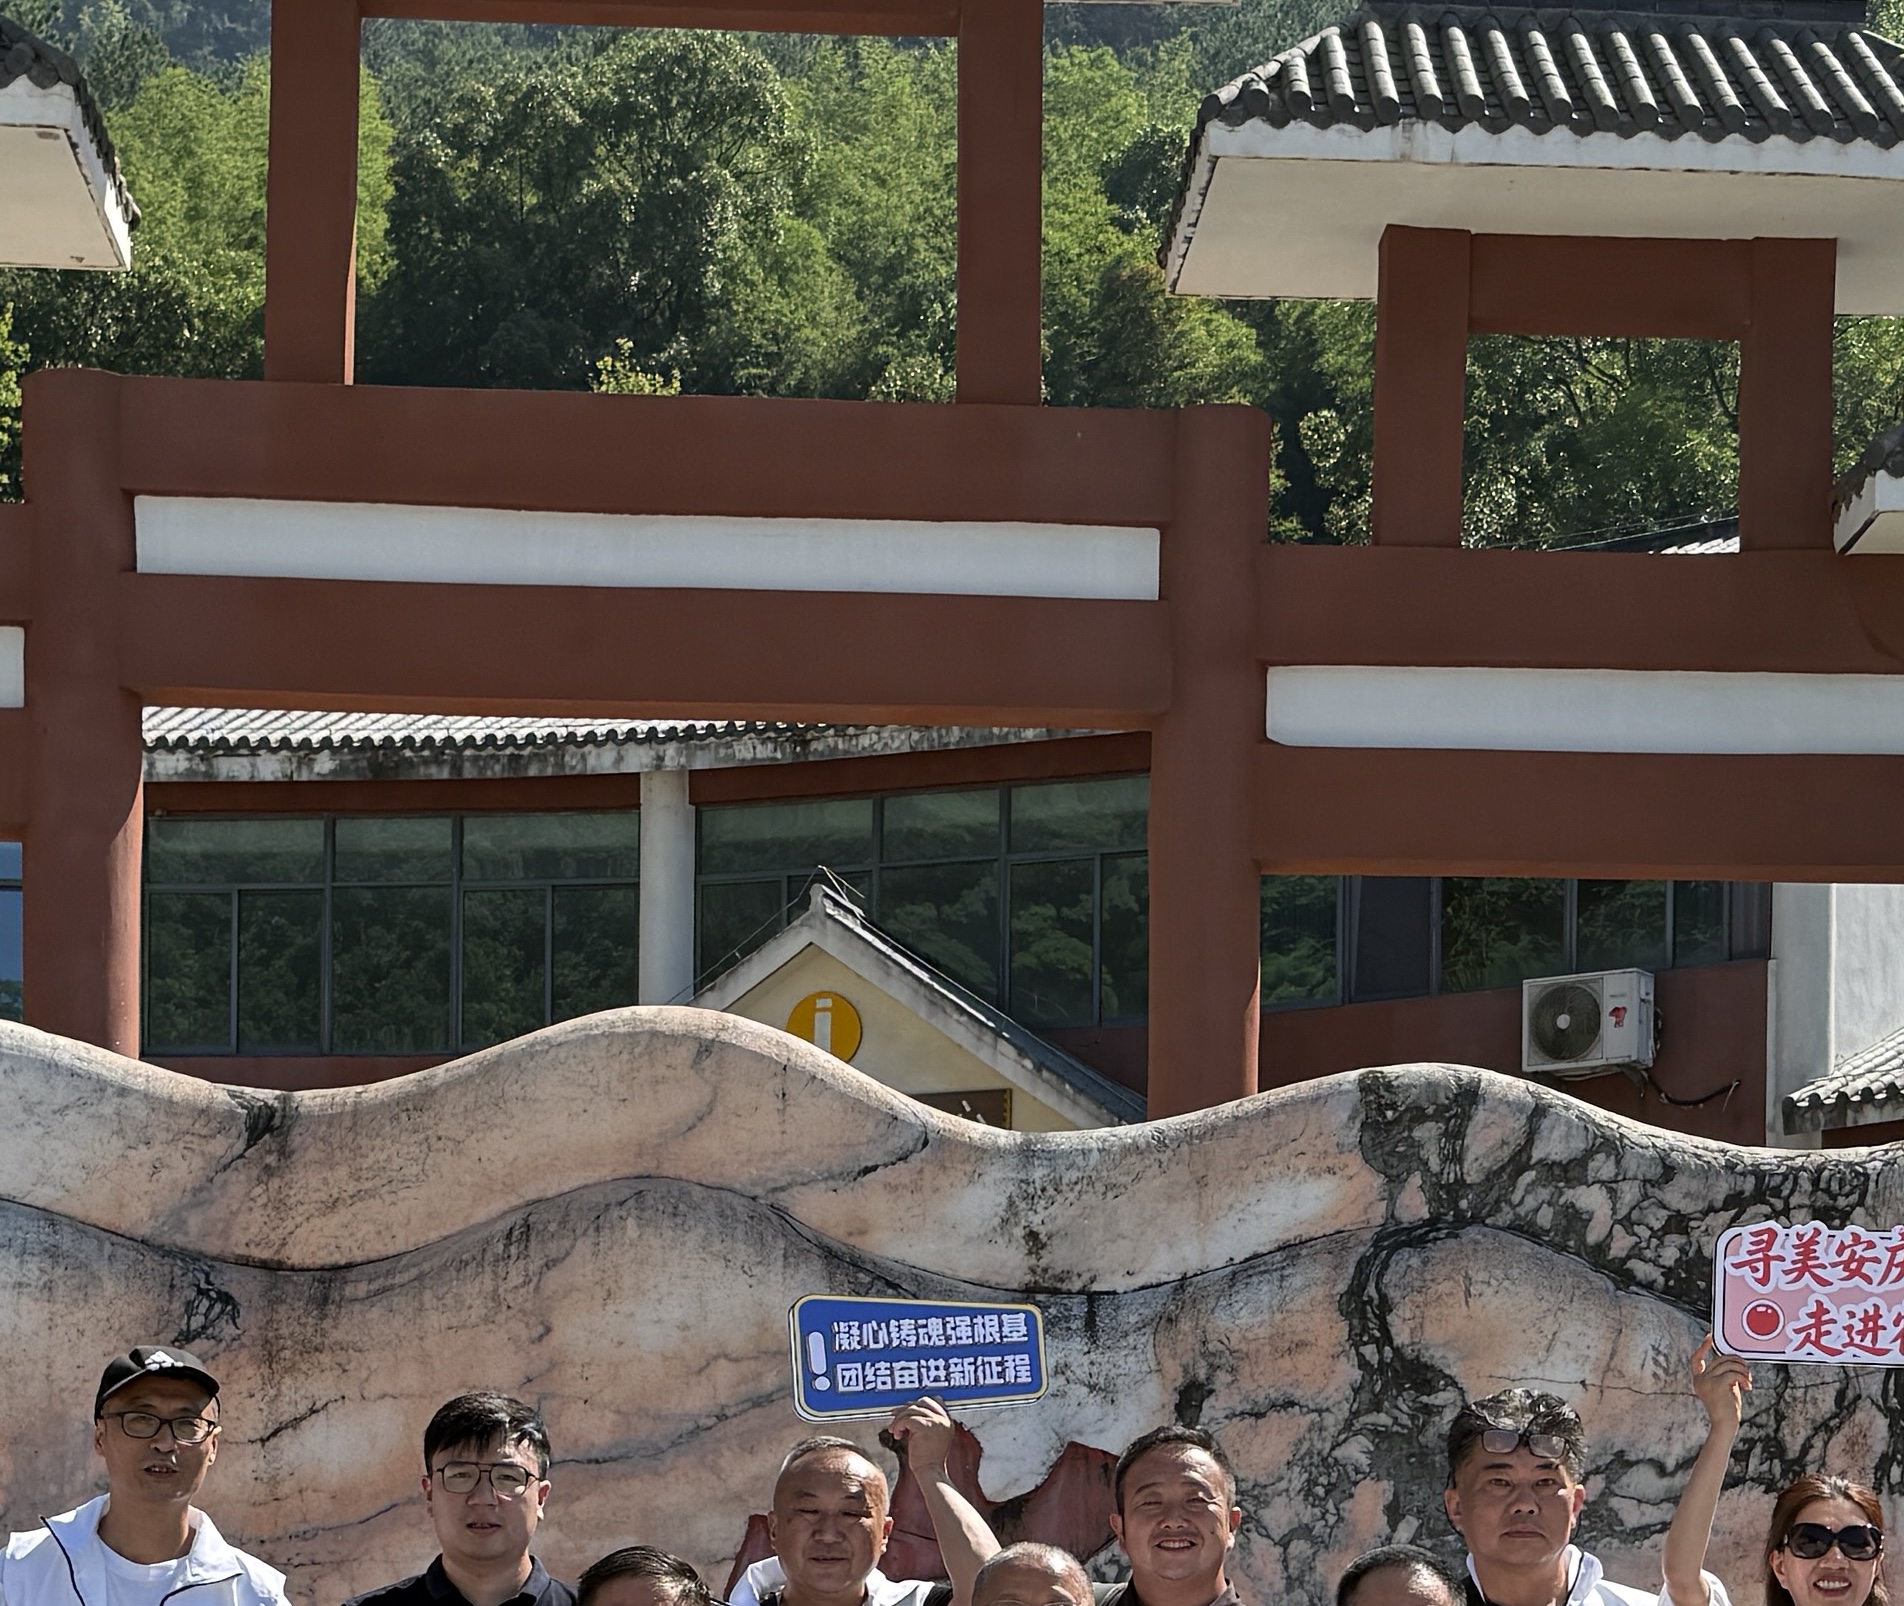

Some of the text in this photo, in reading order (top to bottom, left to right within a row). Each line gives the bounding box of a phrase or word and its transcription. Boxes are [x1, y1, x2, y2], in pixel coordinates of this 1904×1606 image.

[832, 1312, 1029, 1351] 凝心铸魂强根基
[836, 1353, 1033, 1393] 团结奋进新征程
